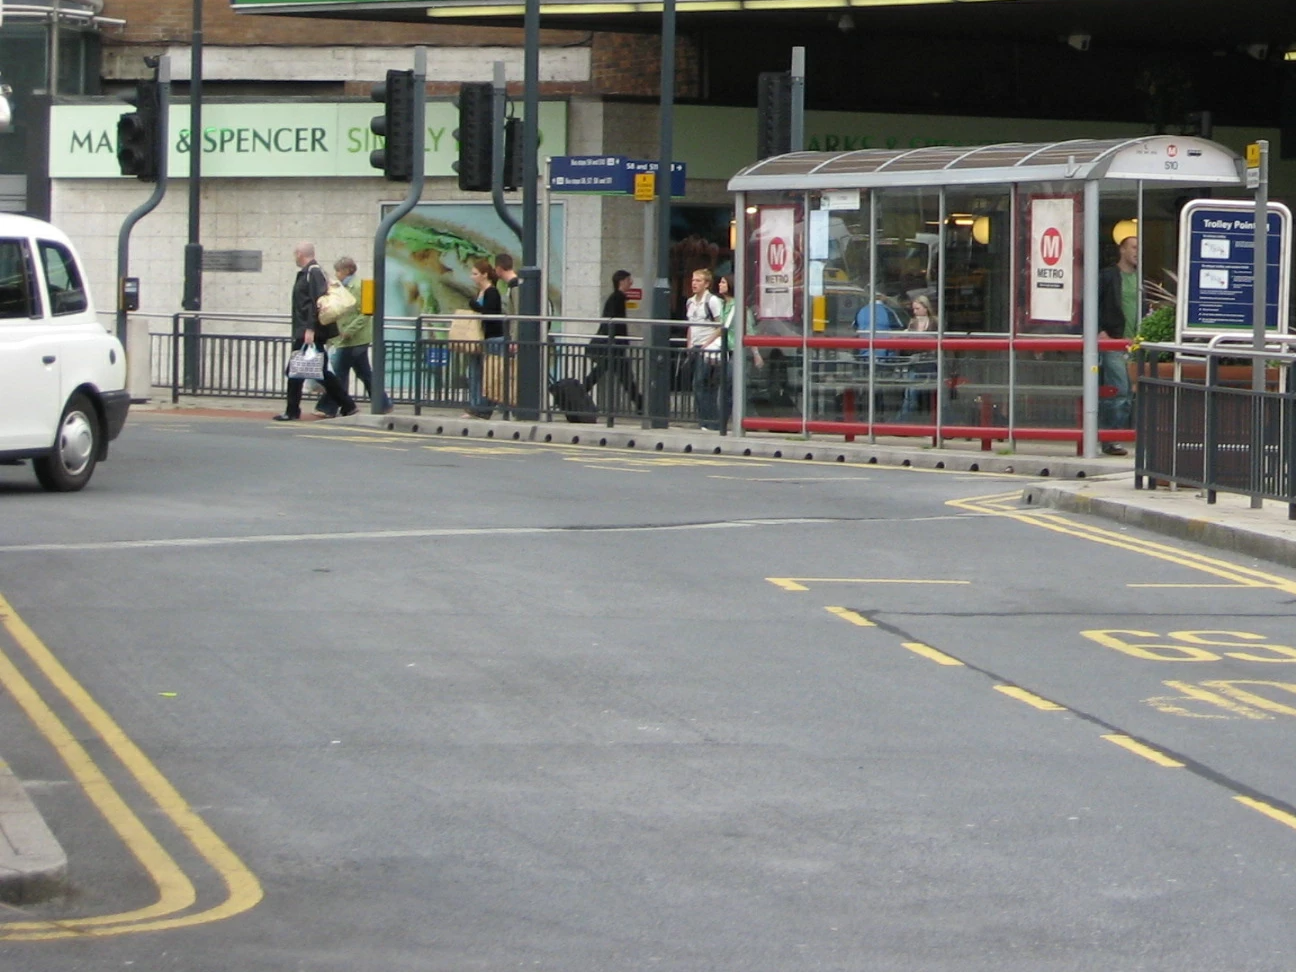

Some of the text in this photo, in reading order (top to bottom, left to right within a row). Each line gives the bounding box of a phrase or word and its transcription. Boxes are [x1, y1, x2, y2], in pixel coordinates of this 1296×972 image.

[203, 127, 329, 153] SPENCER
[1204, 218, 1232, 231] Trolley
[1037, 268, 1064, 279] METRO
